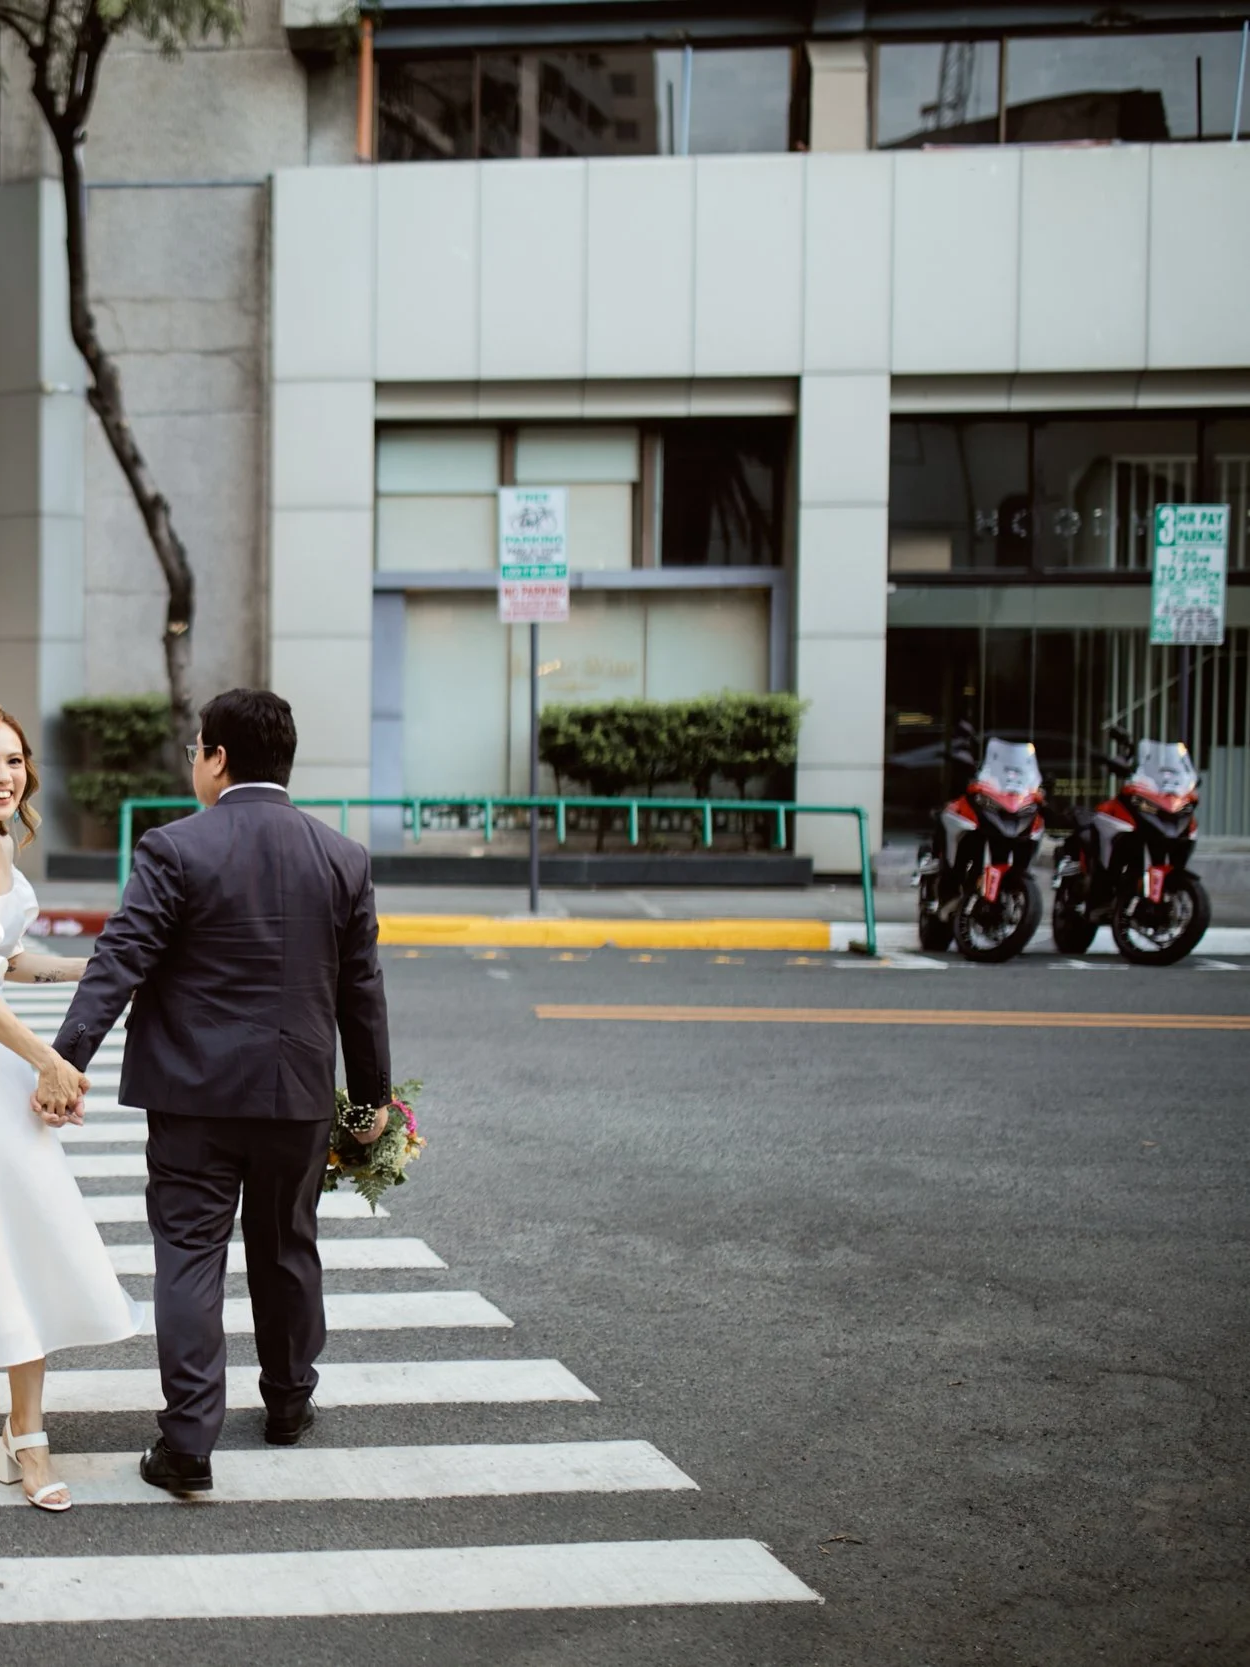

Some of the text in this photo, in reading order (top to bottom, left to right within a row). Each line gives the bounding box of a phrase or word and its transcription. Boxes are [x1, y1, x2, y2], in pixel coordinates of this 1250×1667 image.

[1159, 508, 1175, 544] 3
[1200, 512, 1224, 525] PAY
[1177, 529, 1223, 542] PARKING
[1159, 566, 1176, 581] TO
[504, 586, 566, 597] NO PARKING
